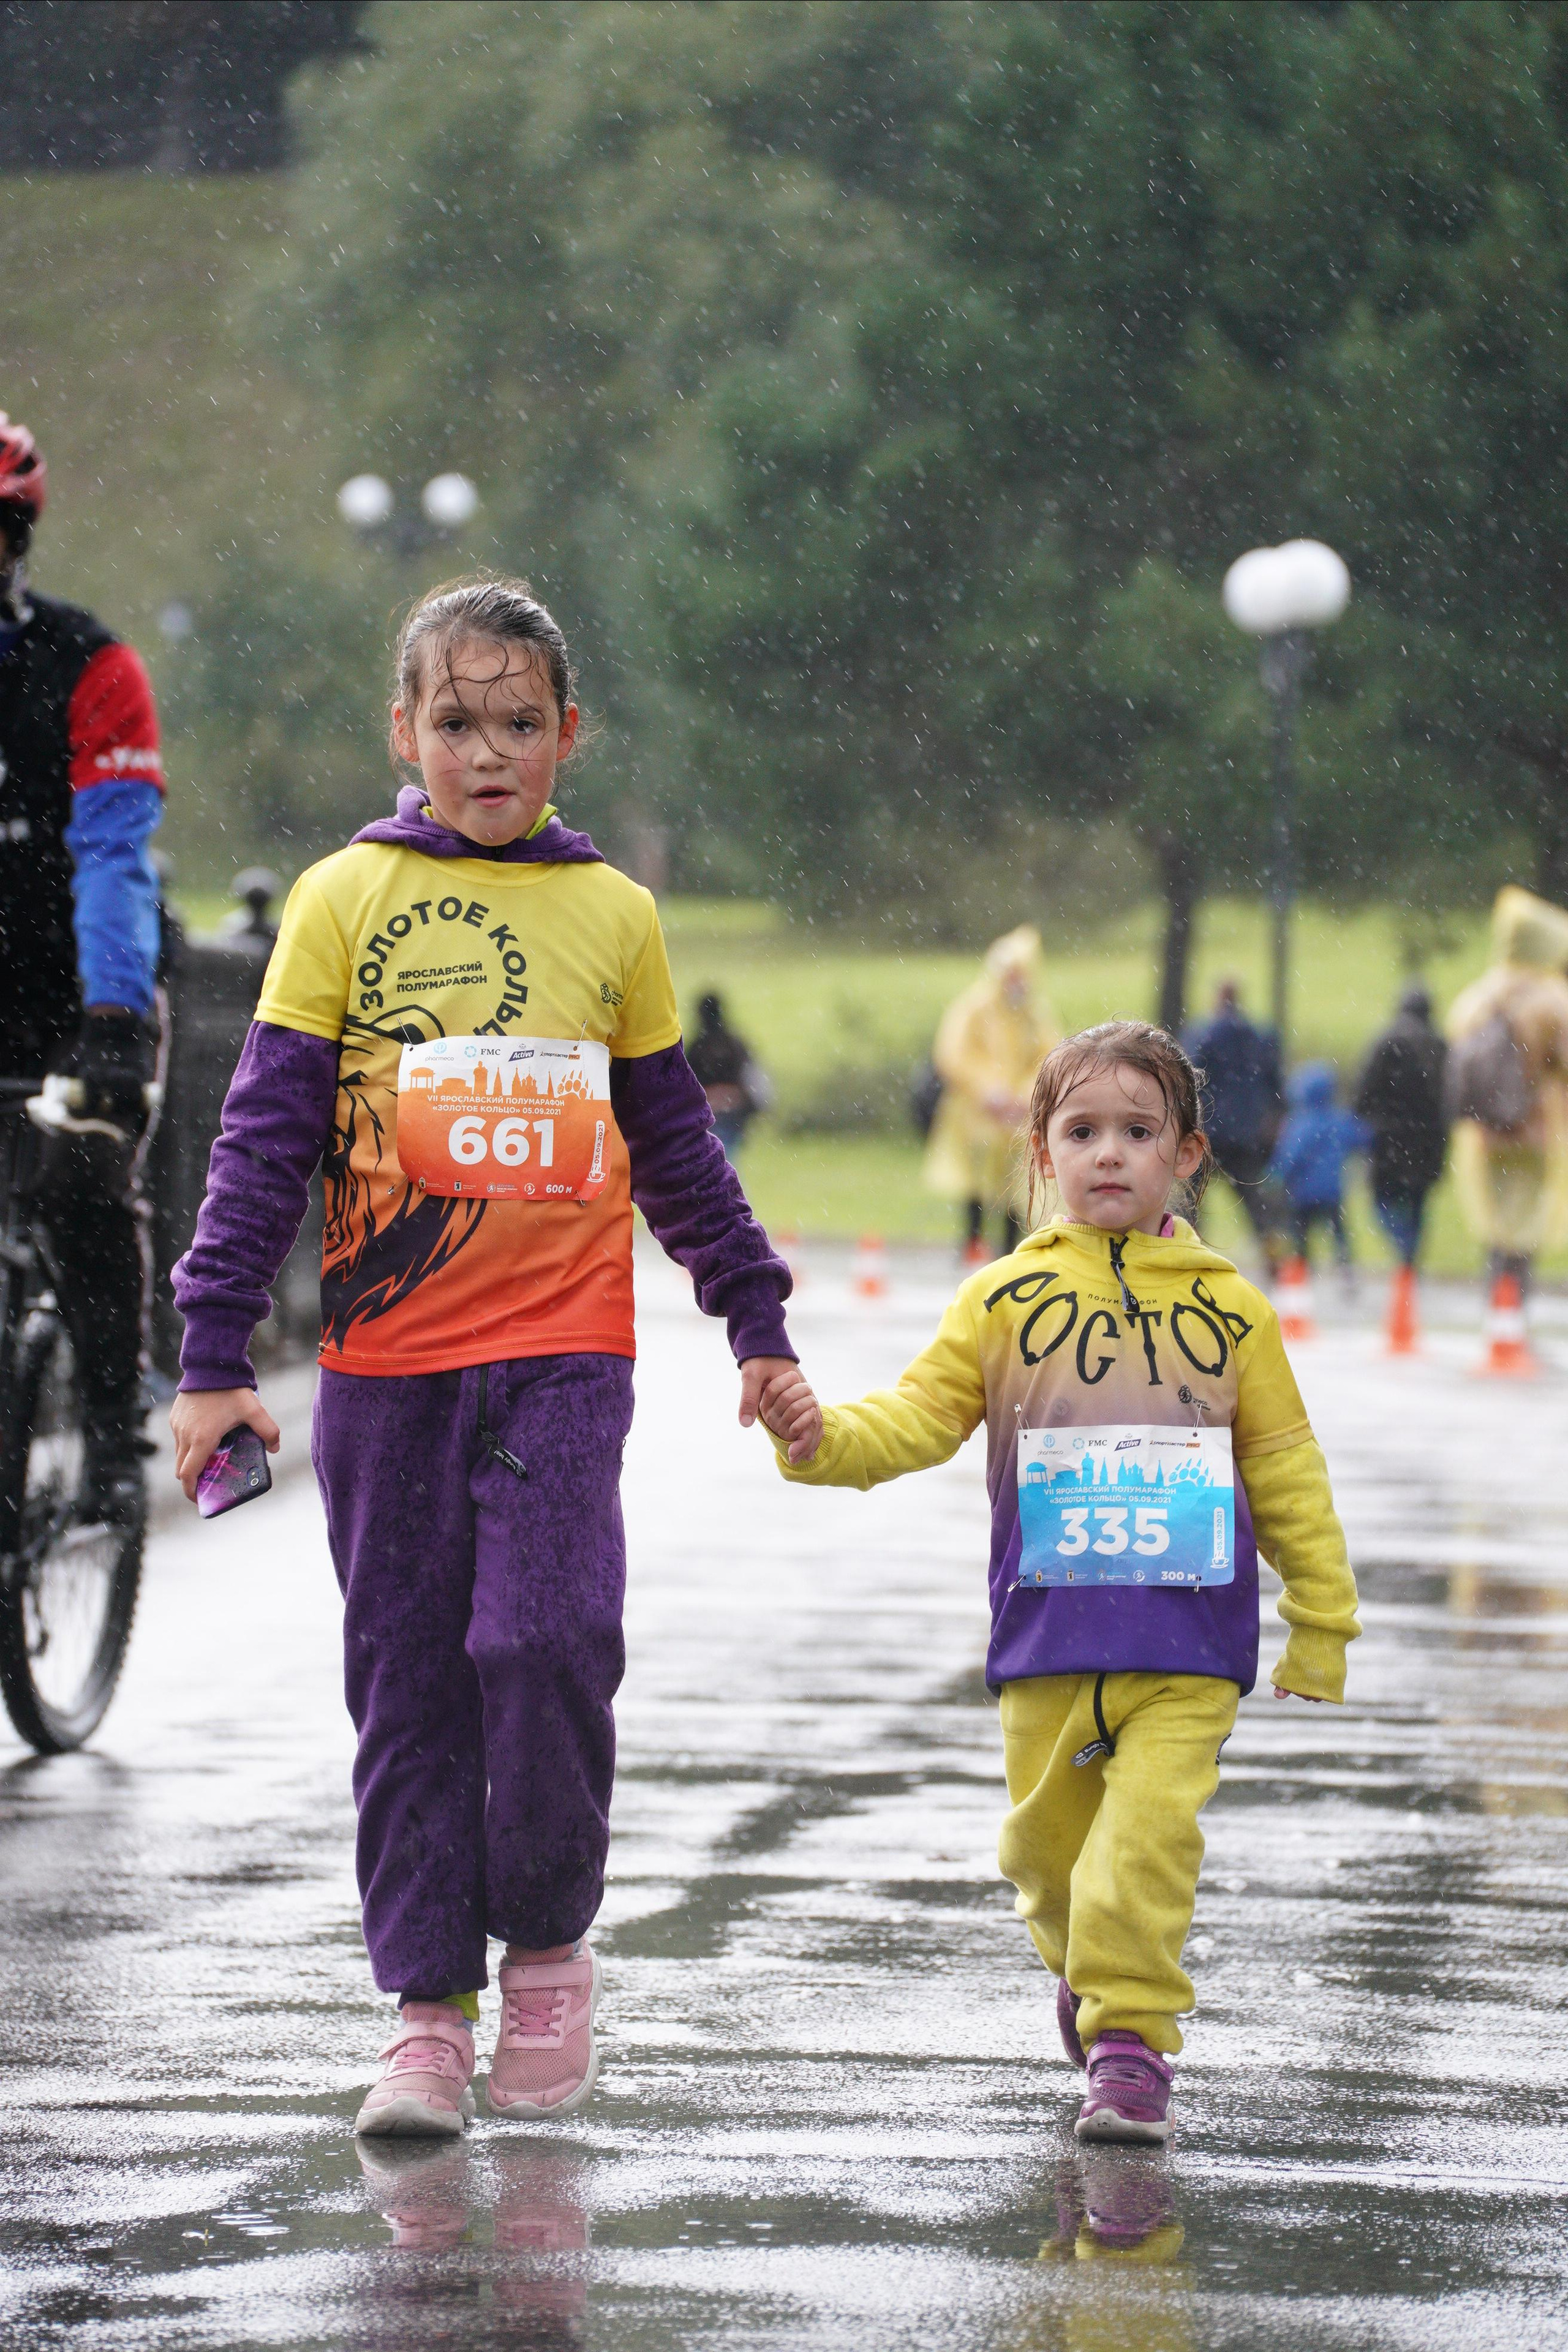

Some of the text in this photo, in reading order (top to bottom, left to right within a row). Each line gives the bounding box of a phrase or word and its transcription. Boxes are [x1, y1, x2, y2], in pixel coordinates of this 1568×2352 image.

[358, 895, 529, 1036] ЗОЛОТОЕ КОЛЬЦ
[397, 960, 483, 980] ЯРОСЛАВСКИЙ
[396, 974, 488, 993] ПОЛУМАРАФОН
[513, 1050, 532, 1059] Active
[440, 1094, 503, 1104] ЯРОСЛАВСКИЙ
[505, 1097, 565, 1106] ПОЛУМАРАФОН
[480, 1106, 521, 1114] КОЛЬЦО»
[448, 1115, 554, 1167] 661
[594, 1124, 603, 1164] 05.09.2021
[546, 1184, 564, 1194] 600
[1088, 1293, 1158, 1305] ПОЛУМФОН
[1118, 1439, 1139, 1449] Active
[1056, 1485, 1109, 1495] ЯРОСЛАВСКИЙ
[1111, 1486, 1177, 1495] ПОЛУМАРАФОН
[1050, 1496, 1087, 1504] «ЗОЛОТОЕ
[1055, 1507, 1170, 1556] 335
[1161, 1570, 1185, 1581] 300
